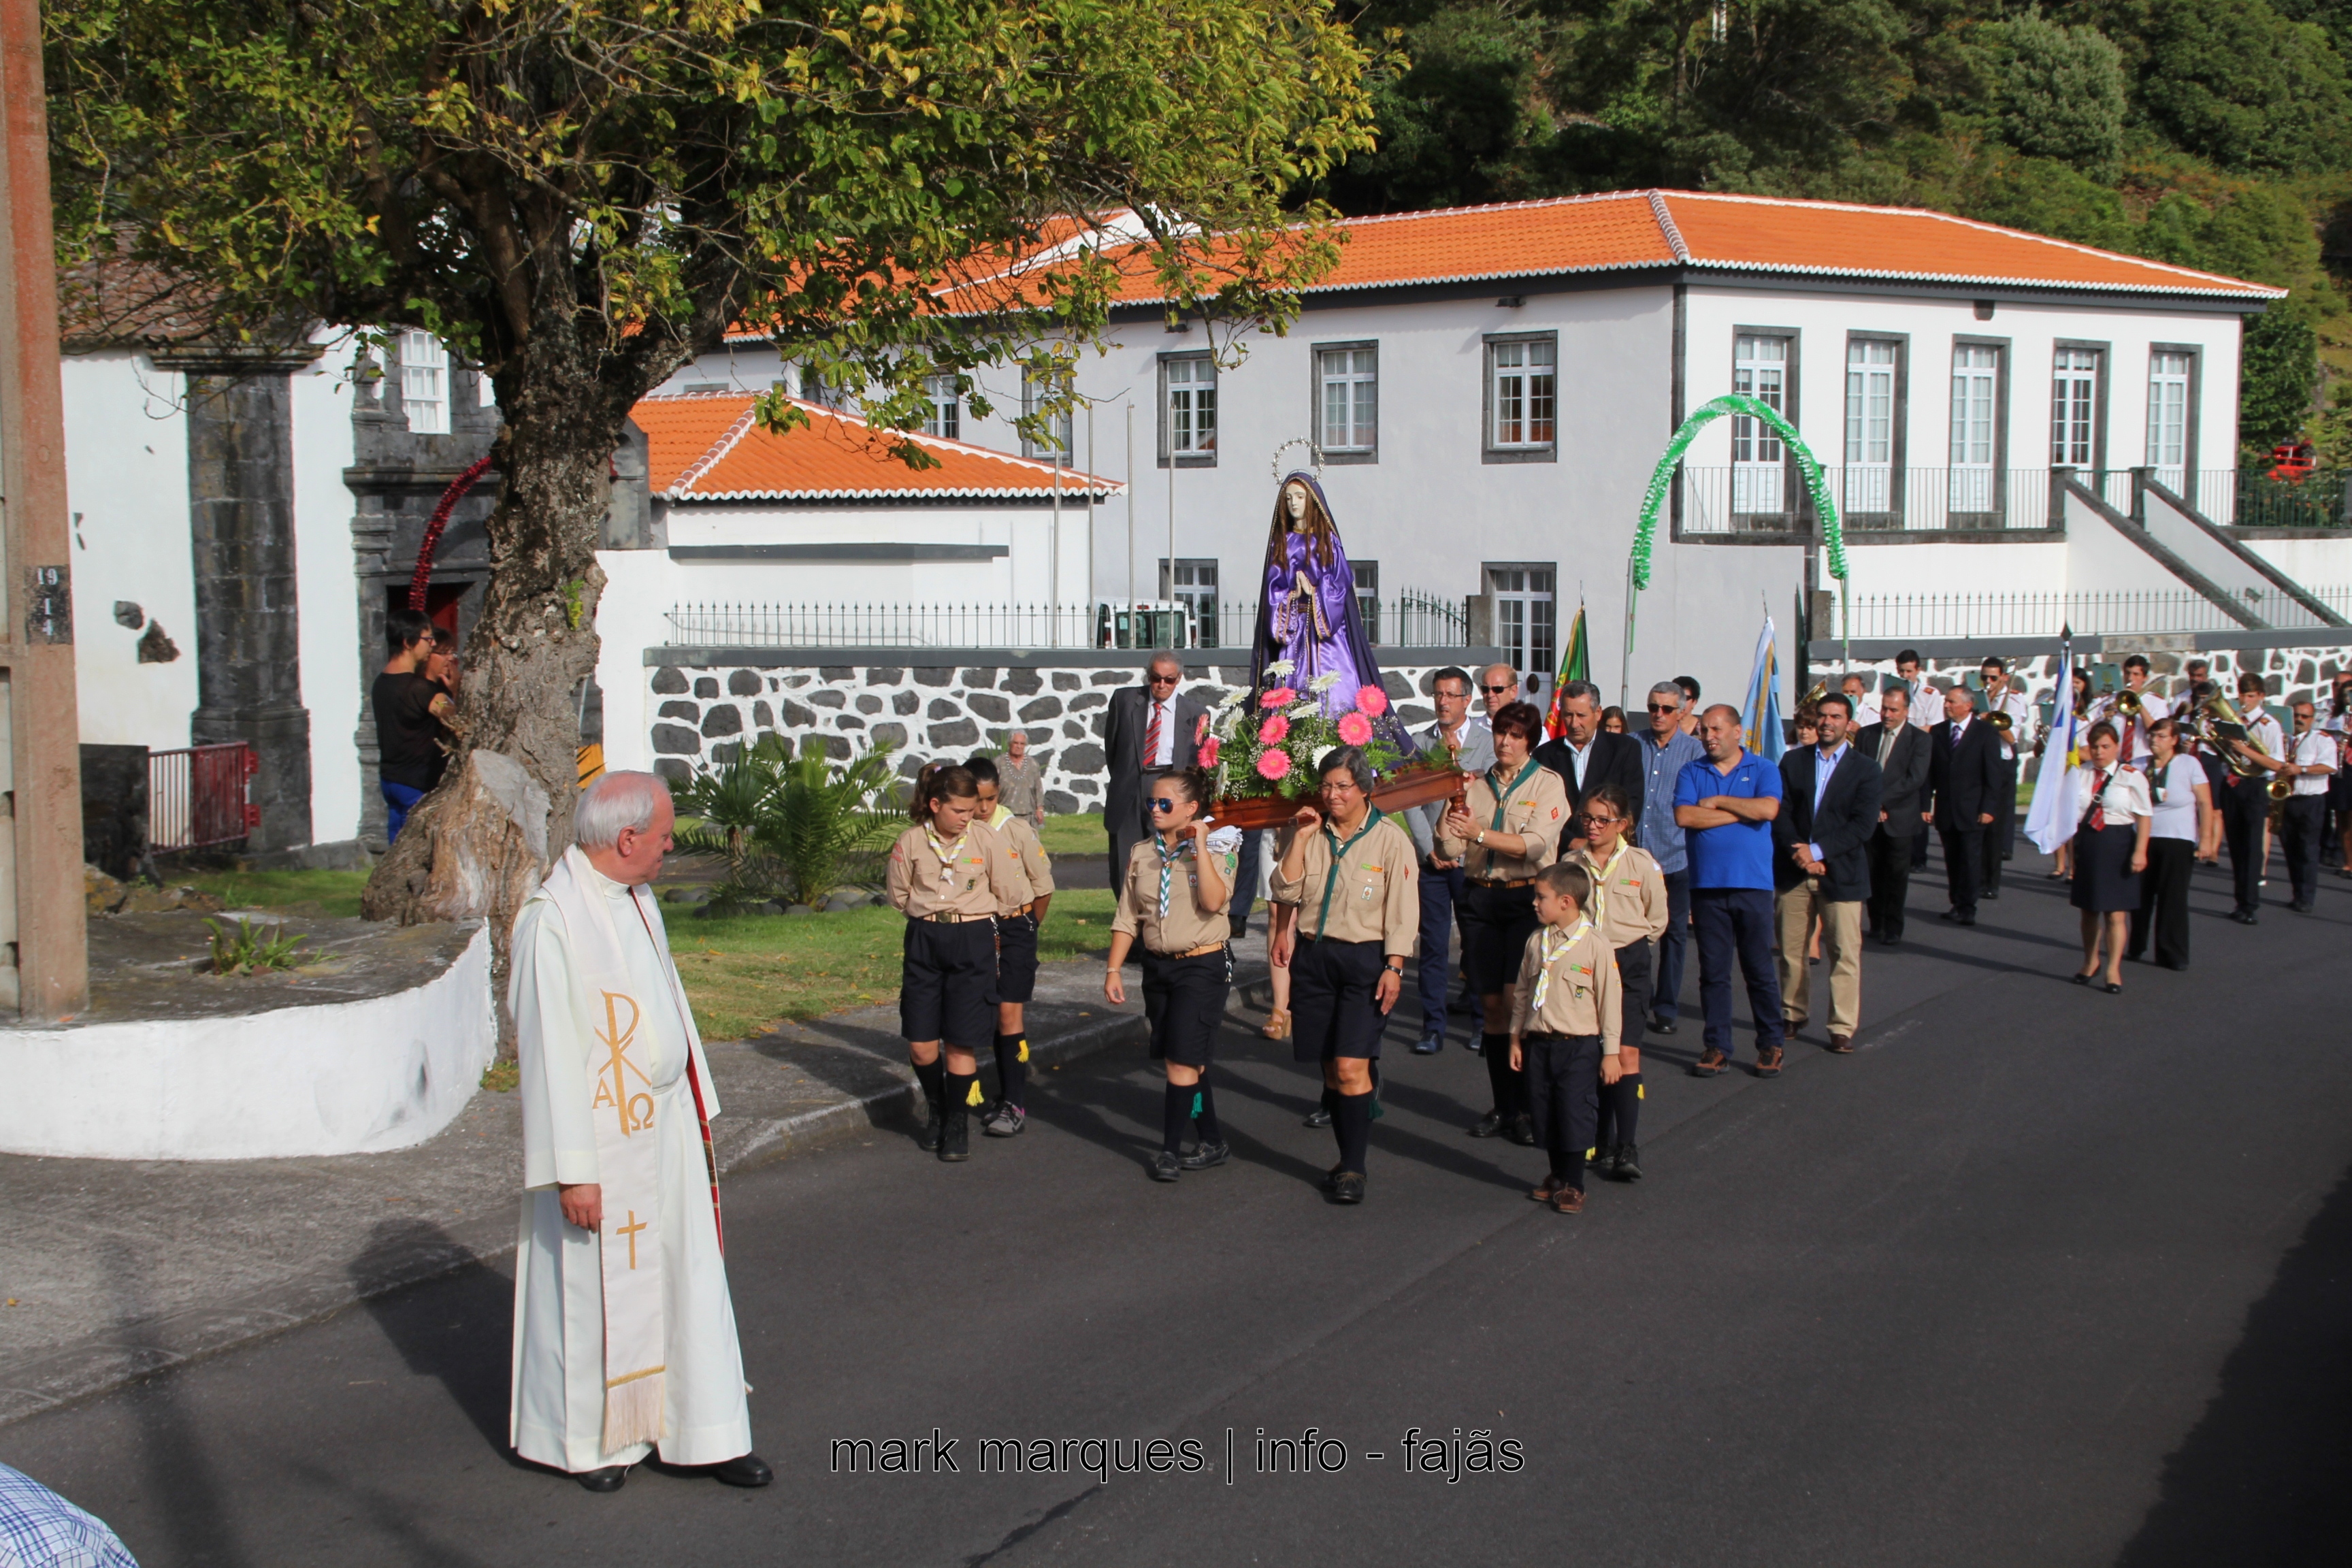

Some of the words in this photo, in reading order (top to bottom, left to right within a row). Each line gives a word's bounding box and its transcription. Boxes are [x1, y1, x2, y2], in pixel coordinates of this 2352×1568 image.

[37, 568, 59, 585] 19
[44, 598, 51, 615] 1
[42, 619, 54, 636] 4
[627, 1092, 654, 1131] Ω
